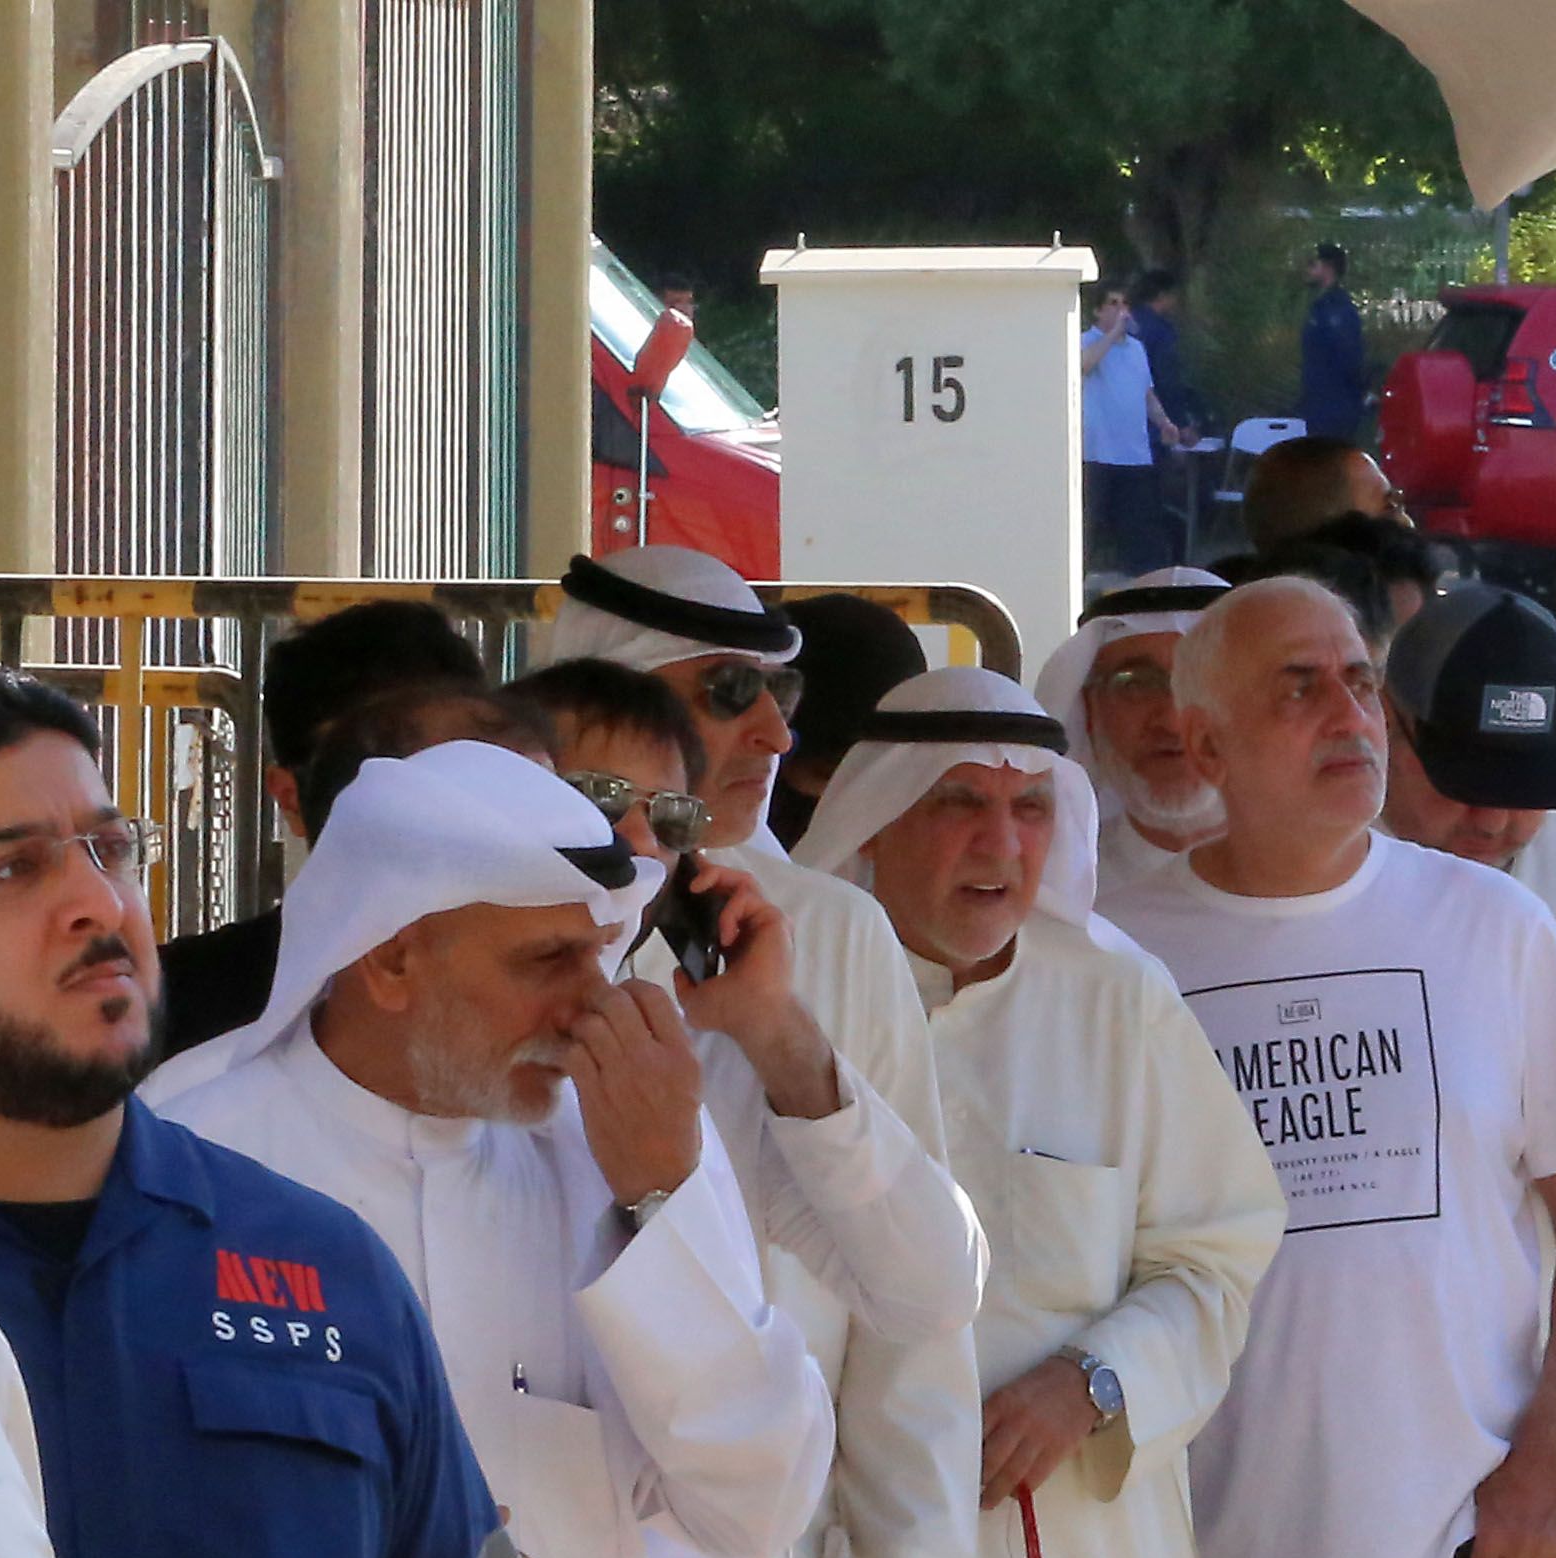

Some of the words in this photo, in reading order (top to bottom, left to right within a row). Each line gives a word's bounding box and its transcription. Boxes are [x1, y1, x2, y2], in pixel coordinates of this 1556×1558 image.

[895, 355, 966, 423] 15
[1253, 1088, 1367, 1147] EAGLE
[1272, 1157, 1317, 1170] EVENTY
[215, 1248, 326, 1312] MEW
